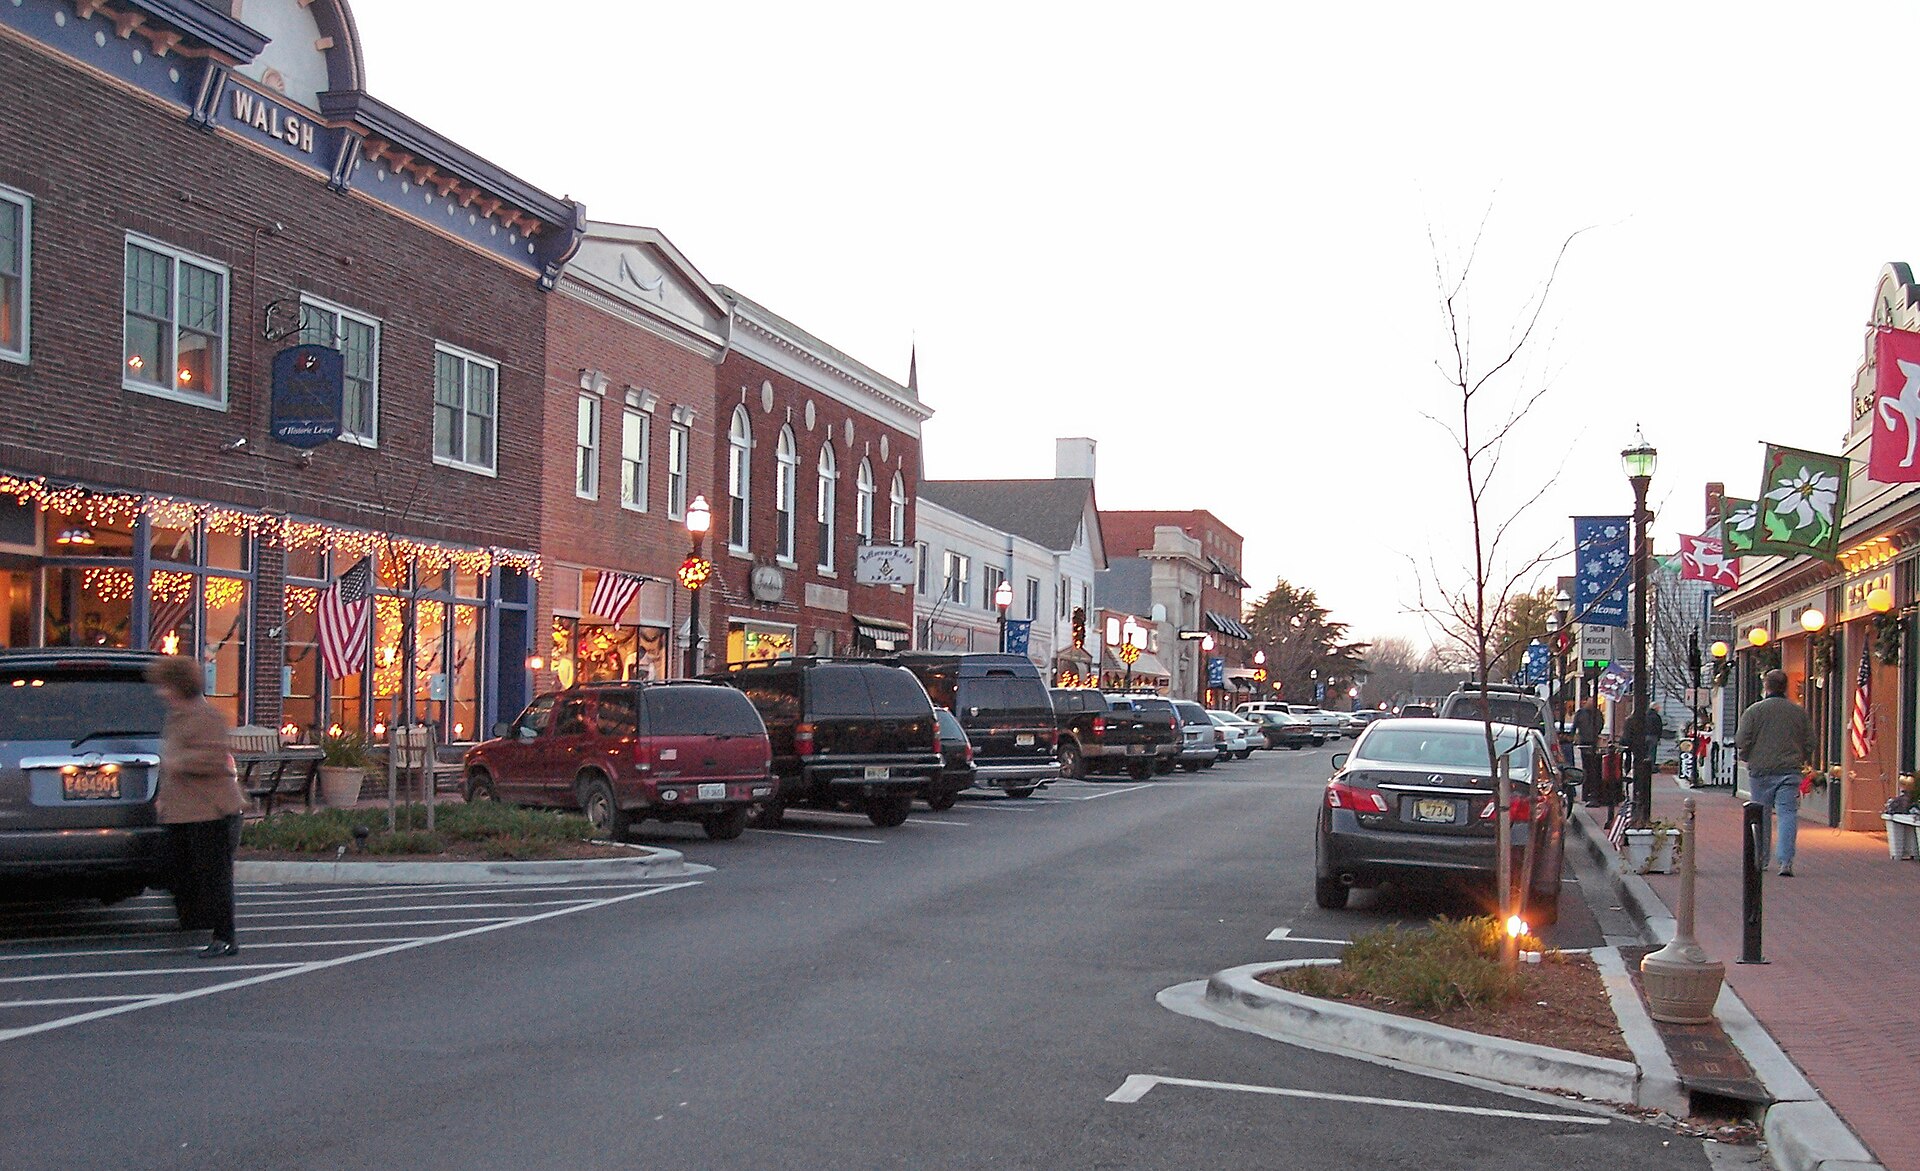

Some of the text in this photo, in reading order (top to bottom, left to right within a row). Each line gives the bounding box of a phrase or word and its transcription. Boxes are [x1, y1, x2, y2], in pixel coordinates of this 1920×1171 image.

[232, 90, 314, 153] WALSH
[278, 427, 288, 436] of
[1583, 603, 1623, 615] Welcome
[1589, 625, 1605, 633] SNOW
[1584, 636, 1611, 644] EMERGENCY
[1587, 647, 1606, 656] ROUTE
